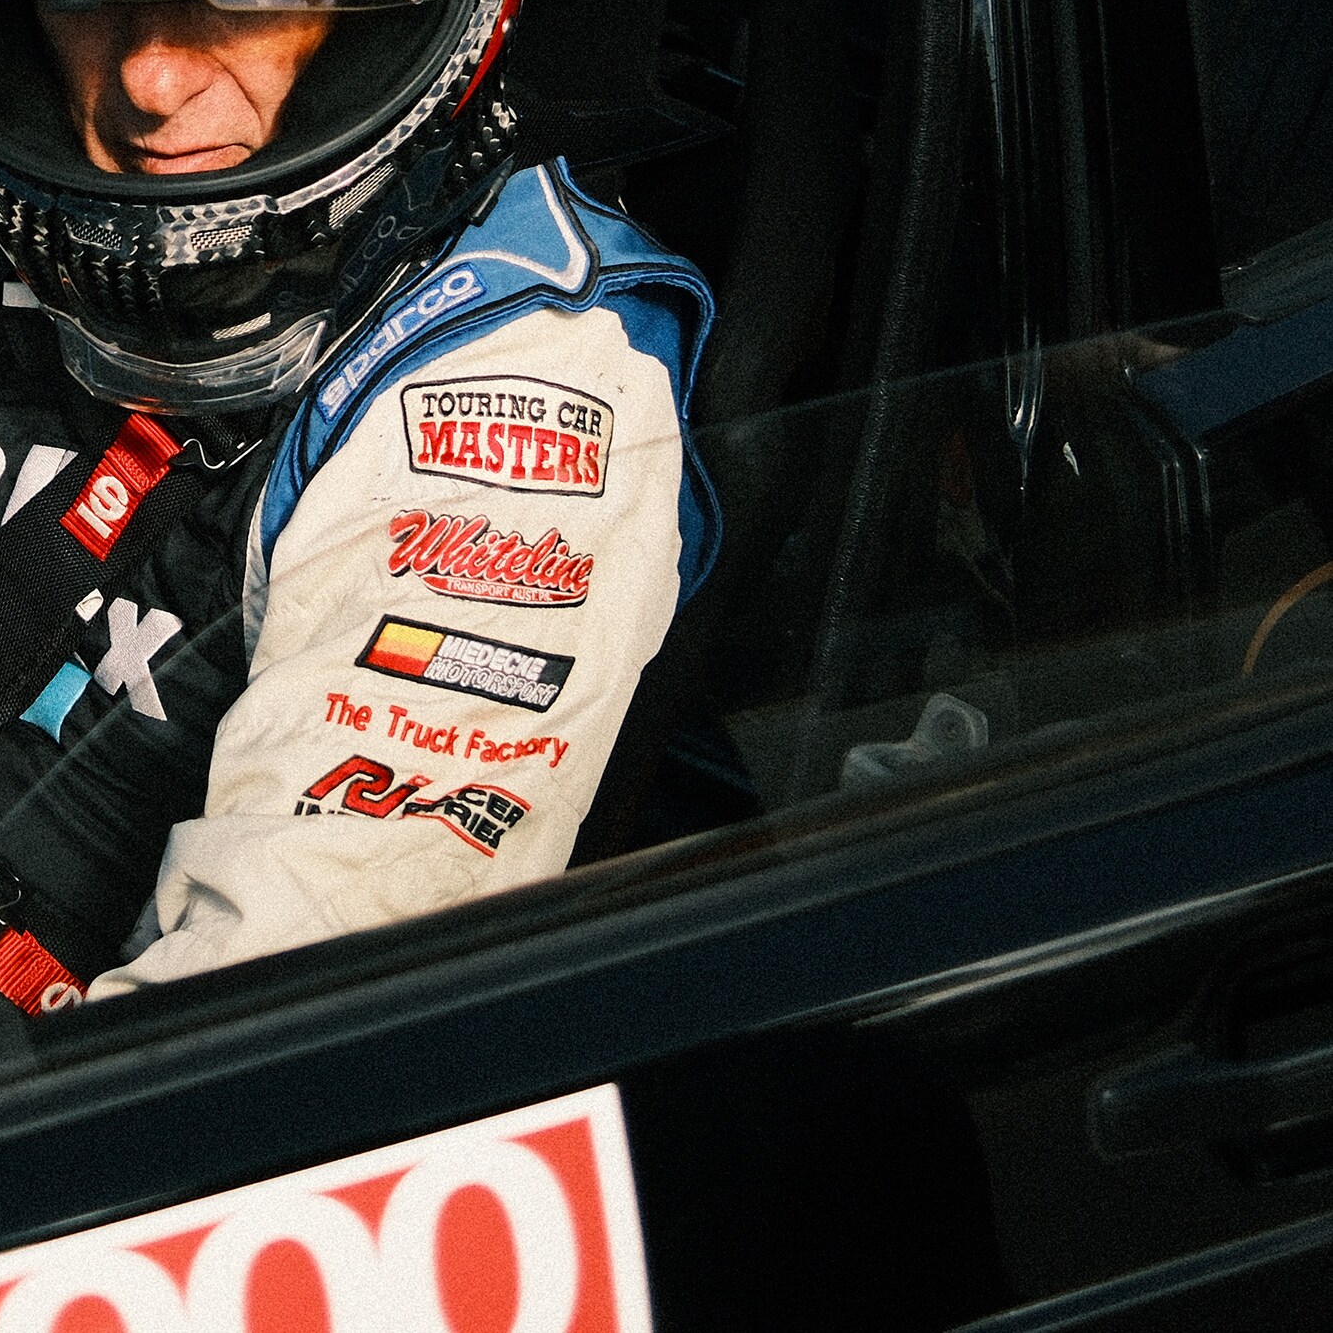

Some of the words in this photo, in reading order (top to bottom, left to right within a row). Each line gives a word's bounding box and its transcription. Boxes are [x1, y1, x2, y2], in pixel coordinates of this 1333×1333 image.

[319, 268, 483, 415] sparco
[423, 392, 546, 423] TOURING
[557, 406, 603, 438] CAR
[417, 421, 599, 488] MASTERS
[387, 509, 594, 596] Whiteline
[446, 579, 512, 598] TRANSPORT
[423, 656, 559, 707] MOTORSPORT
[437, 634, 548, 682] MIEDECKE
[325, 692, 373, 732] The
[387, 704, 460, 756] Truck
[464, 728, 570, 769] Factory
